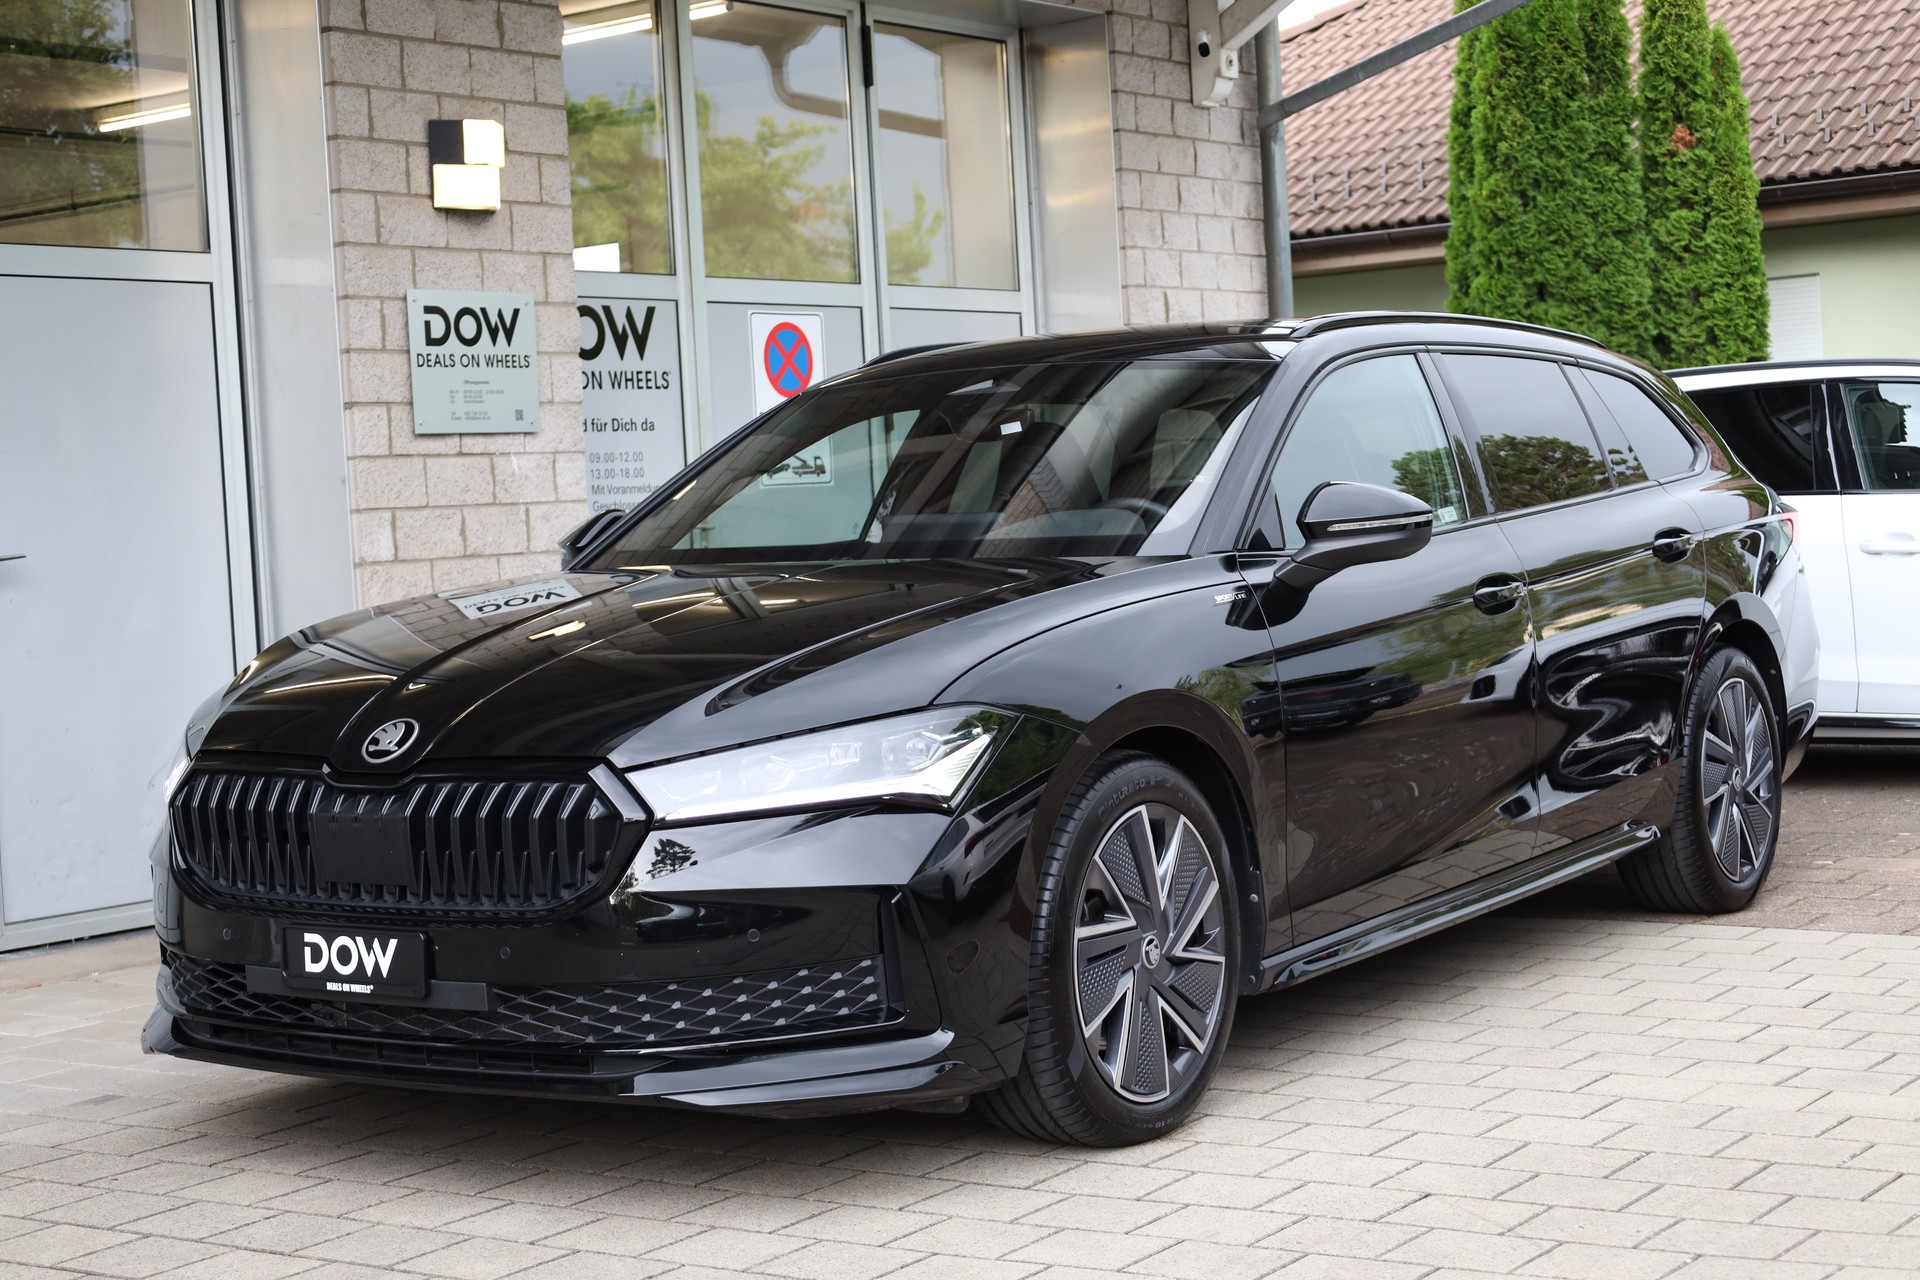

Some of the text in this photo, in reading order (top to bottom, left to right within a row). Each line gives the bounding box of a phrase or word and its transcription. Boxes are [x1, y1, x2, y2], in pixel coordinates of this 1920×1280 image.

[423, 305, 520, 348] DOW
[416, 353, 456, 368] DEALS
[460, 353, 480, 368] ON
[591, 417, 608, 432] für
[611, 417, 637, 432] Dich
[641, 417, 655, 432] da
[590, 467, 644, 479] 13.00-18.00
[591, 484, 605, 495] Mit
[303, 932, 399, 979] DOW
[326, 981, 342, 991] DEALS
